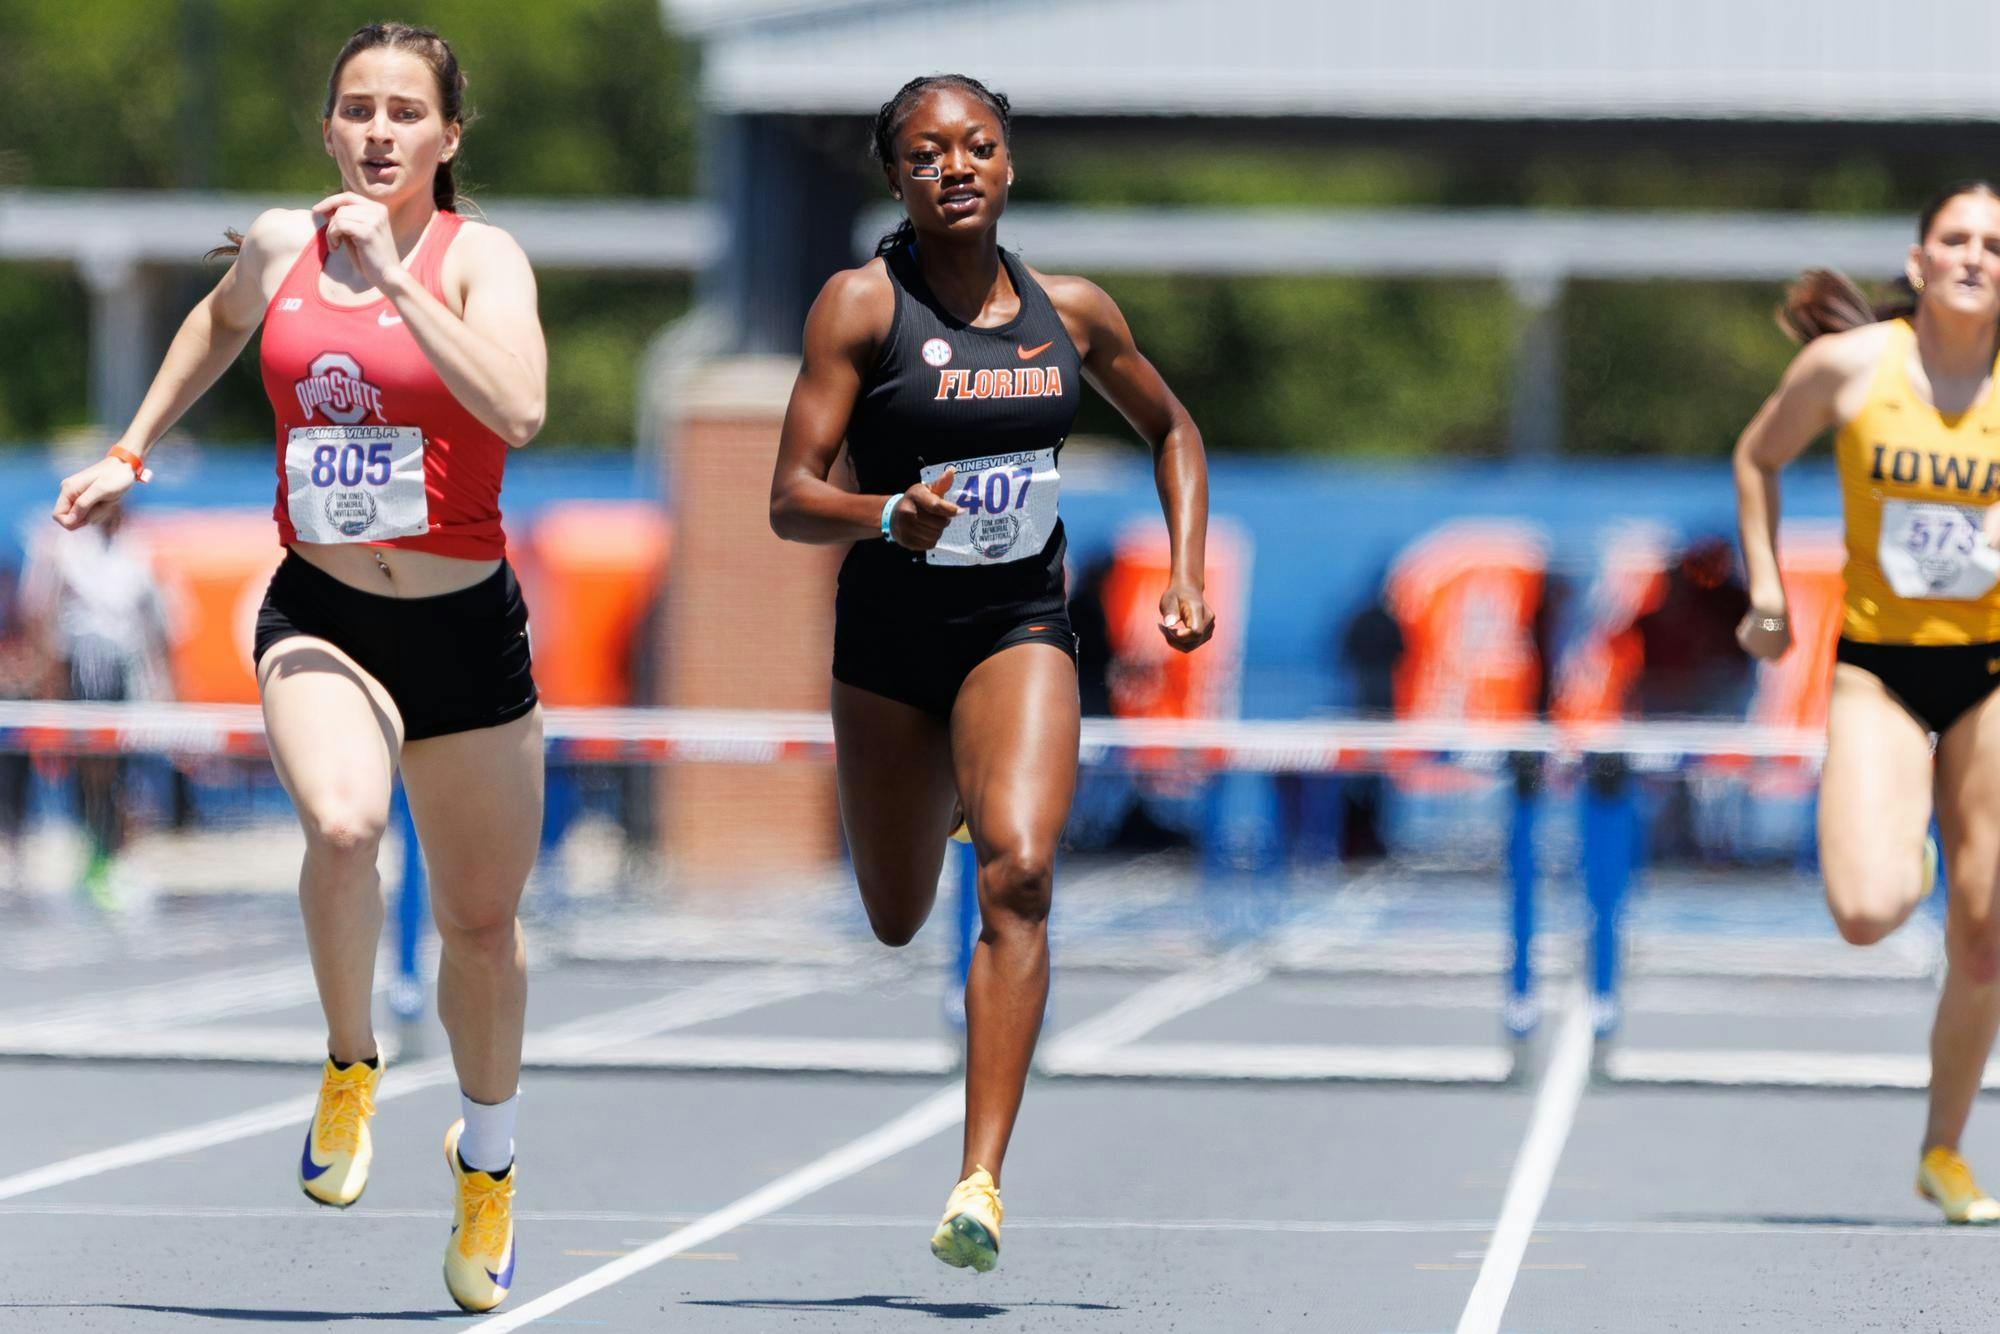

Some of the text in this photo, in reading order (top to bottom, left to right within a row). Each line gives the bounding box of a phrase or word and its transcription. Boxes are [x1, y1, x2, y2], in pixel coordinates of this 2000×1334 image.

[934, 366, 1062, 400] FLORIDA
[382, 428, 399, 438] FL
[311, 443, 393, 488] 805
[956, 467, 1033, 515] 407
[1907, 516, 1976, 556] 573
